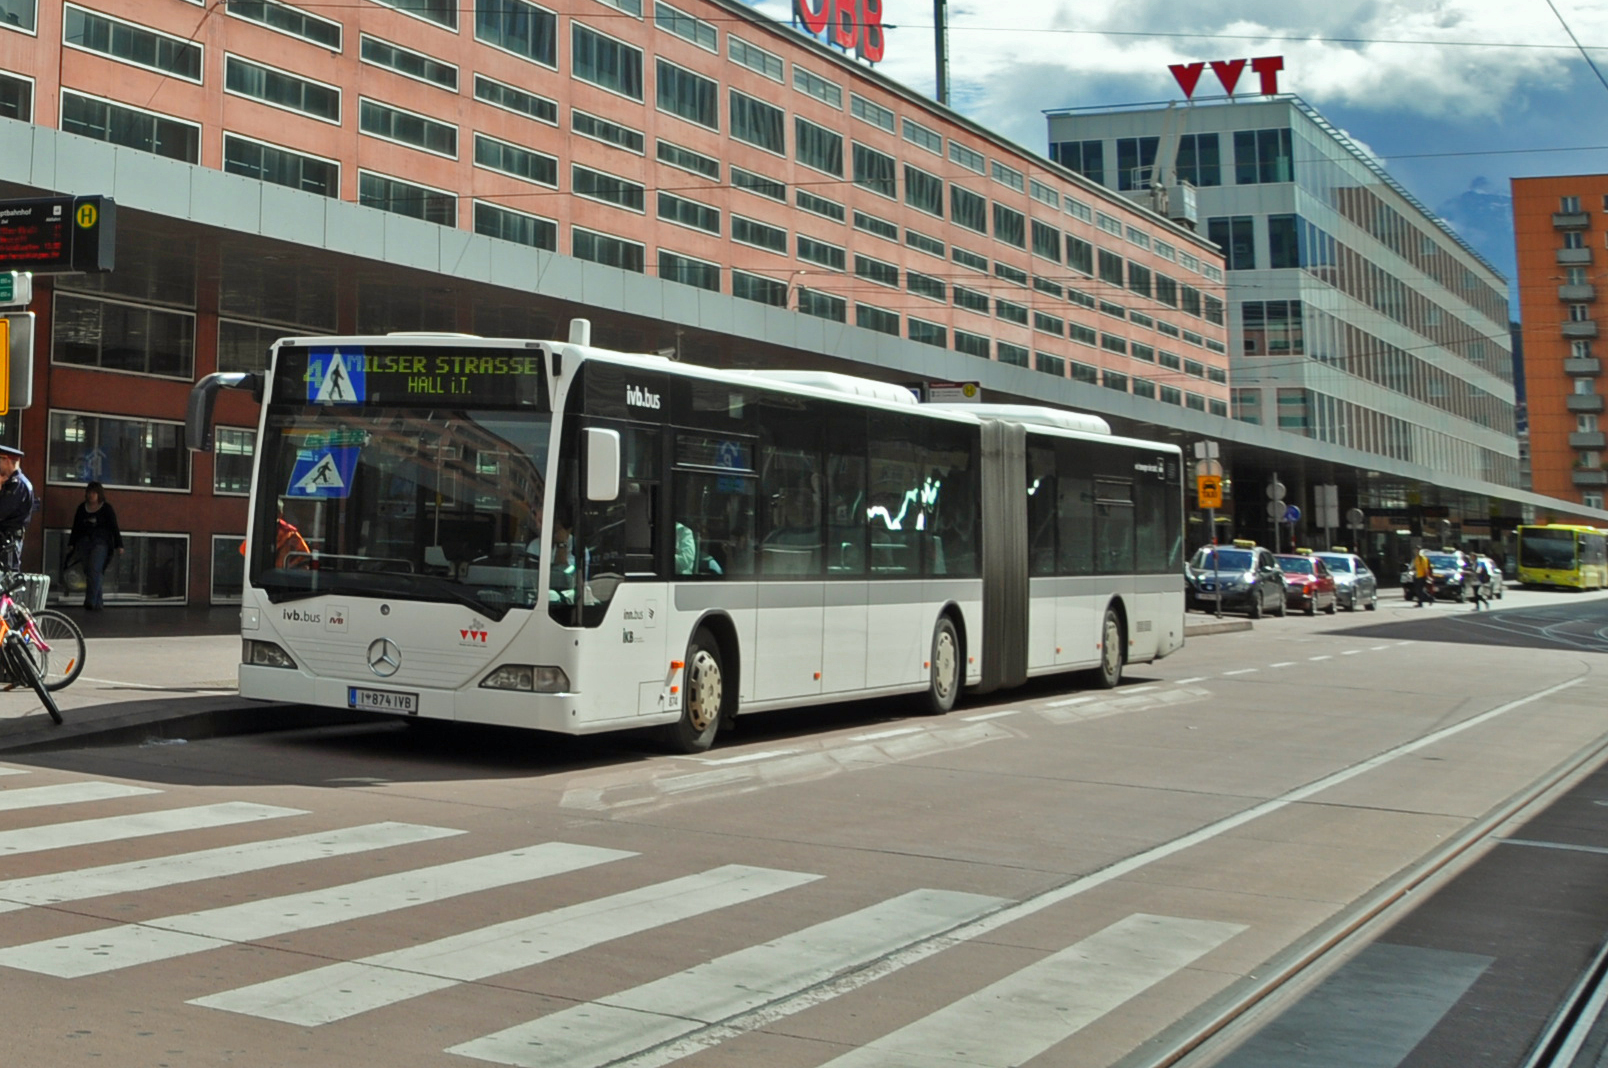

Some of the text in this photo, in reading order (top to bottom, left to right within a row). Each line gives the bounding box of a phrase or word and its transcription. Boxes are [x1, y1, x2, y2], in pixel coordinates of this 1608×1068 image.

[1168, 56, 1284, 100] VVT
[81, 208, 92, 224] H
[303, 359, 323, 388] 4
[347, 355, 539, 375] MILSER STRASSE
[408, 376, 444, 393] HALL
[626, 384, 661, 409] ivb.bus
[282, 608, 321, 623] ivb.bus
[459, 629, 488, 643] VVT
[372, 693, 391, 707] 874
[394, 696, 411, 709] IVB
